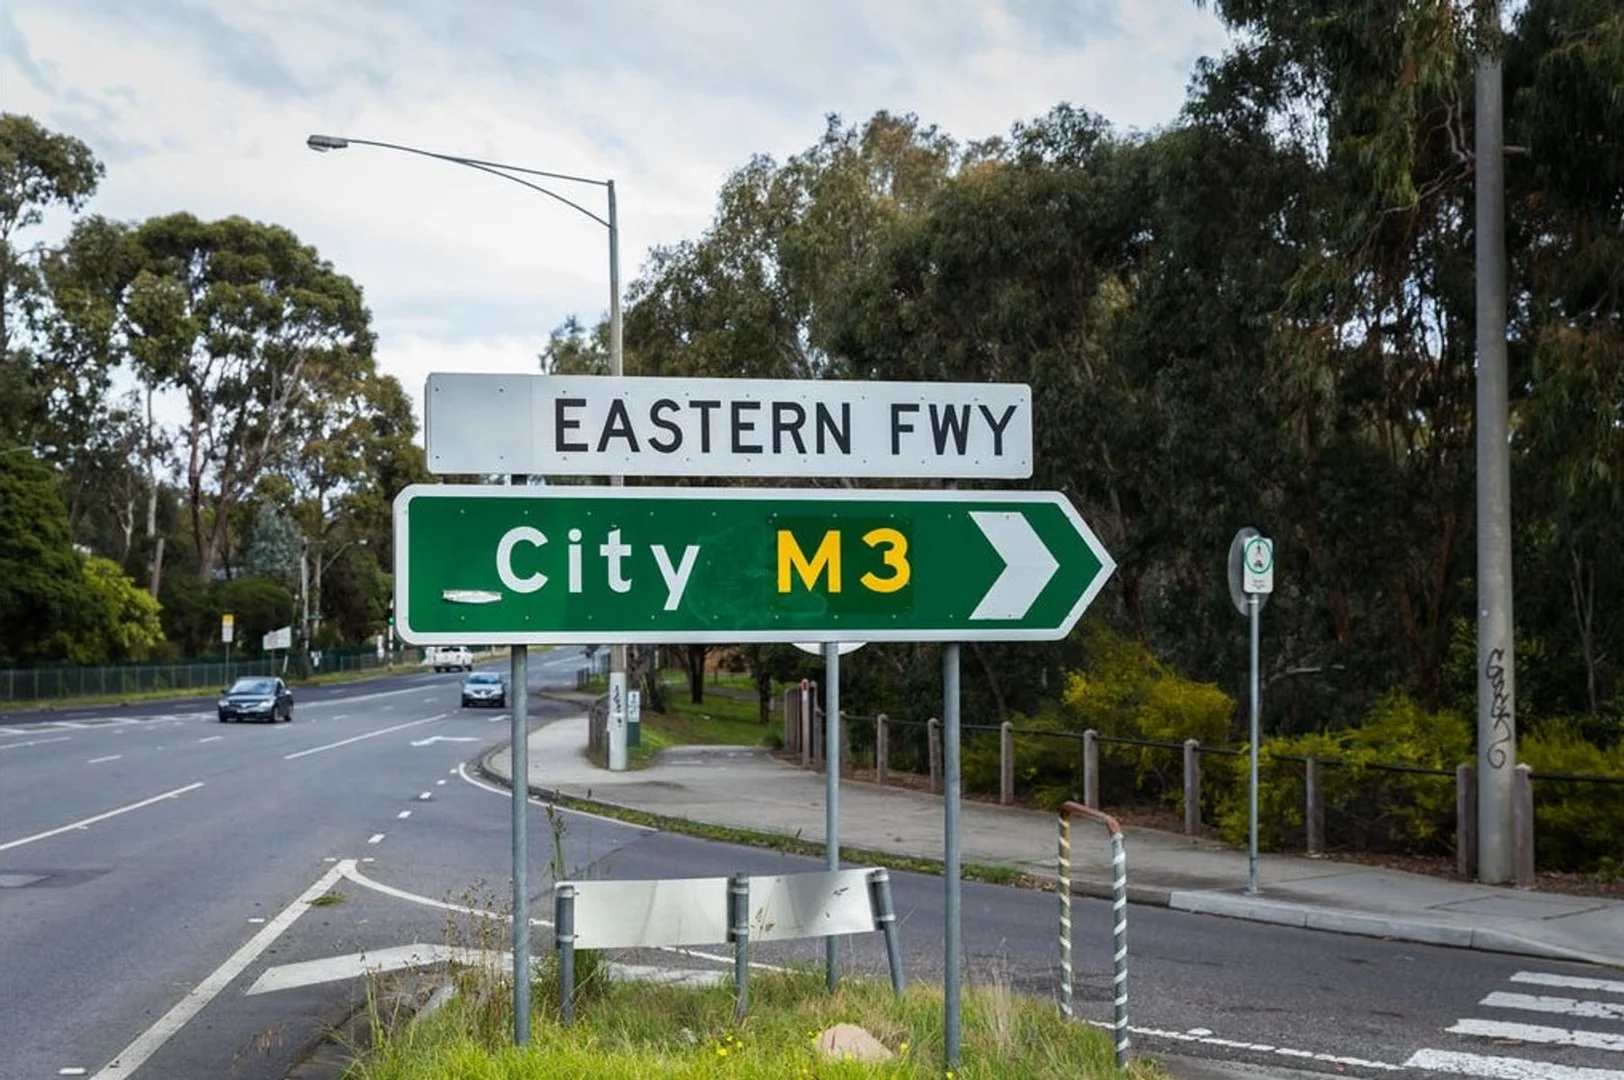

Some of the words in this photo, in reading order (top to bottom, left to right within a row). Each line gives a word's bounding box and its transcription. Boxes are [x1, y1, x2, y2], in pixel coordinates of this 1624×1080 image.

[555, 398, 851, 455] EASTERN
[890, 403, 1018, 457] FWY
[496, 526, 700, 611] City
[777, 527, 911, 593] M3
